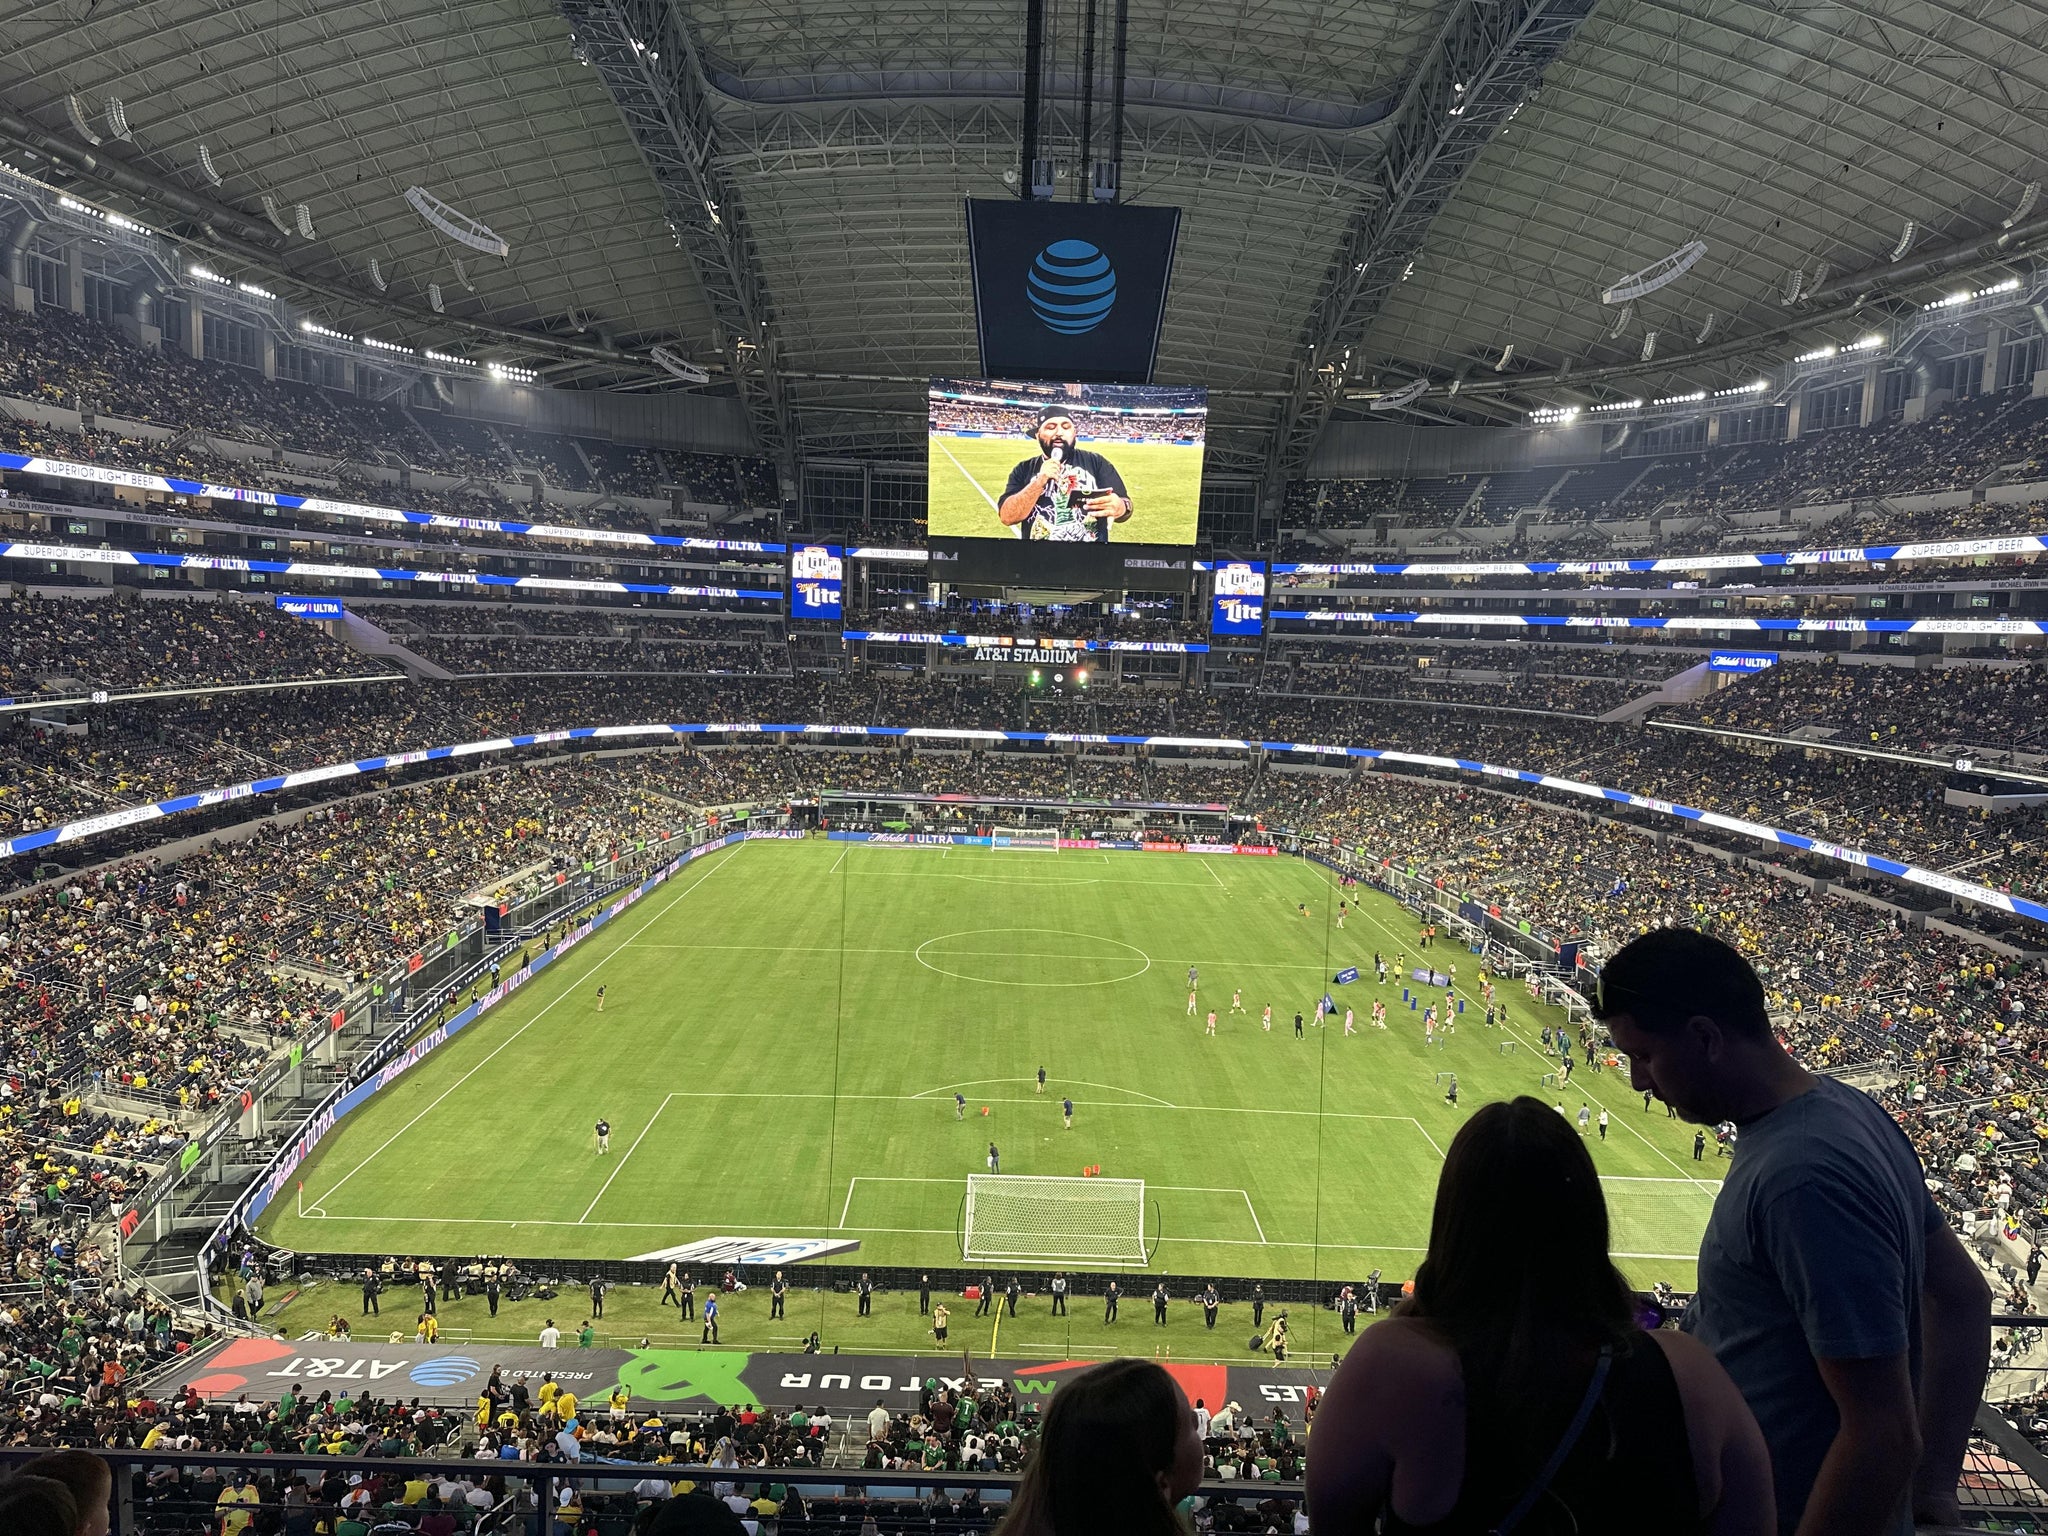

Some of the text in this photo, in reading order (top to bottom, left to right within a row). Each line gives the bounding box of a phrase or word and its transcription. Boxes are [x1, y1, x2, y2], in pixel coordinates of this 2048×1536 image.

[45, 461, 154, 487] SUPERIOR LIGHT BEER
[243, 489, 278, 506] ULTRA
[18, 501, 30, 510] DON
[31, 503, 54, 512] PERKINS
[468, 518, 502, 531] ULTRA
[727, 539, 764, 551] ULTRA
[1912, 538, 2024, 556] SUPERIOR LIGHT BEER
[24, 546, 121, 561] SUPERIOR LIGHT BEER
[1828, 548, 1866, 562] ULTRA
[221, 558, 250, 570] ULTRA
[1341, 564, 1376, 574] ULTRA
[1600, 561, 1630, 571] ULTRA
[449, 574, 478, 584] ULTRA
[2024, 580, 2039, 588] IRVIN
[708, 588, 738, 597] ULTRA
[804, 588, 841, 607] Lite
[313, 603, 339, 613] ULTRA
[1225, 604, 1262, 623] Lite
[1343, 613, 1375, 621] ULTRA
[1603, 616, 1630, 626] ULTRA
[1835, 619, 1867, 631] ULTRA
[1926, 622, 2024, 632] SUPERIOR LIGHT BEER
[909, 634, 943, 643] ULTRA
[1152, 643, 1187, 652] ULTRA
[974, 647, 1078, 664] AT&T STADIUM
[1745, 656, 1773, 668] ULTRA
[840, 726, 869, 734] ULTRA
[1080, 734, 1109, 743] ULTRA
[867, 832, 954, 844] Michelob ULTRA
[709, 838, 726, 851] ULTRA
[1241, 846, 1268, 854] STRAUSS
[575, 921, 594, 940] ULTRA
[509, 964, 533, 991] ULTRA
[375, 1024, 449, 1091] Michelob ULTRA
[306, 1104, 337, 1153] ULTRA
[266, 1358, 410, 1380] AT&T
[409, 1443, 415, 1455] 9
